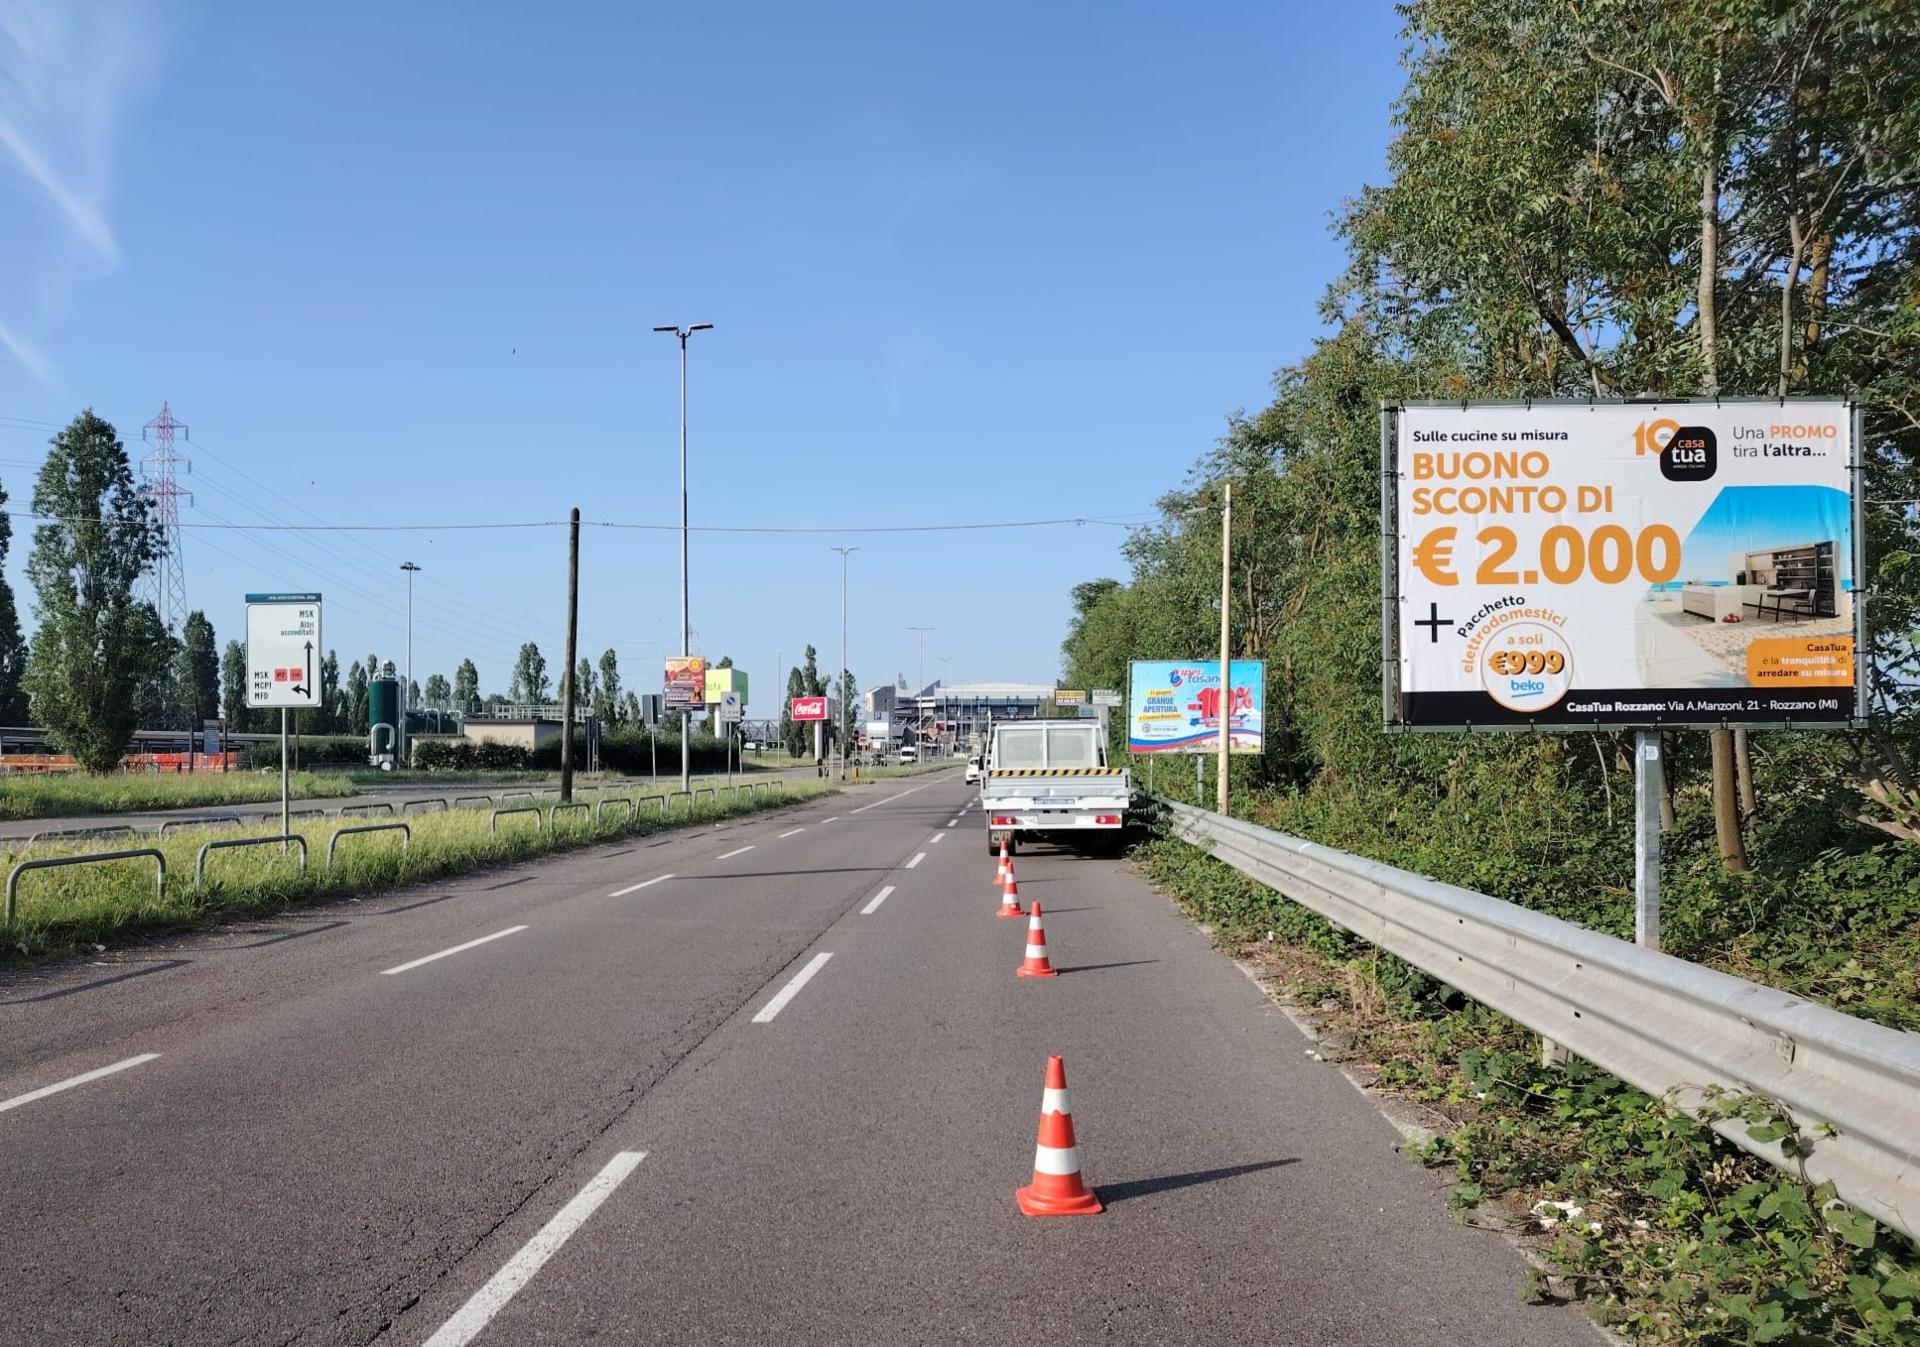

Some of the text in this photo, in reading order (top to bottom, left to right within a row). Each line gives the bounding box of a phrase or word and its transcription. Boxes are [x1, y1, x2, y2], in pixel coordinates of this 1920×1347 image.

[1413, 430, 1568, 442] Sulle cucine su misura
[1733, 425, 1836, 440] Una PROMO
[1678, 439, 1705, 449] casa
[1672, 446, 1706, 463] tua
[1733, 445, 1758, 458] tira
[1413, 451, 1550, 480] BUONO
[1412, 486, 1612, 515] SCONTO DI
[1412, 524, 1681, 586] € 2.000
[1457, 595, 1525, 638] Pacchetto
[1461, 608, 1568, 673] elettrodomestici
[1508, 634, 1543, 645] a soli
[1807, 643, 1847, 652] CasaTua
[1488, 650, 1565, 675] €999
[1771, 657, 1779, 665] la
[1800, 670, 1812, 678] su
[1814, 669, 1847, 677] misura
[1511, 680, 1544, 691] beko
[1143, 705, 1178, 713] APERTURA
[1567, 702, 1612, 712] CasaTua
[1615, 701, 1666, 711] Rozzano:
[1668, 701, 1684, 711] Via
[1687, 700, 1744, 712] A.Manzoni,
[1747, 701, 1760, 710] 21
[1770, 700, 1816, 710] Rozzano
[1818, 699, 1838, 710] (MI)
